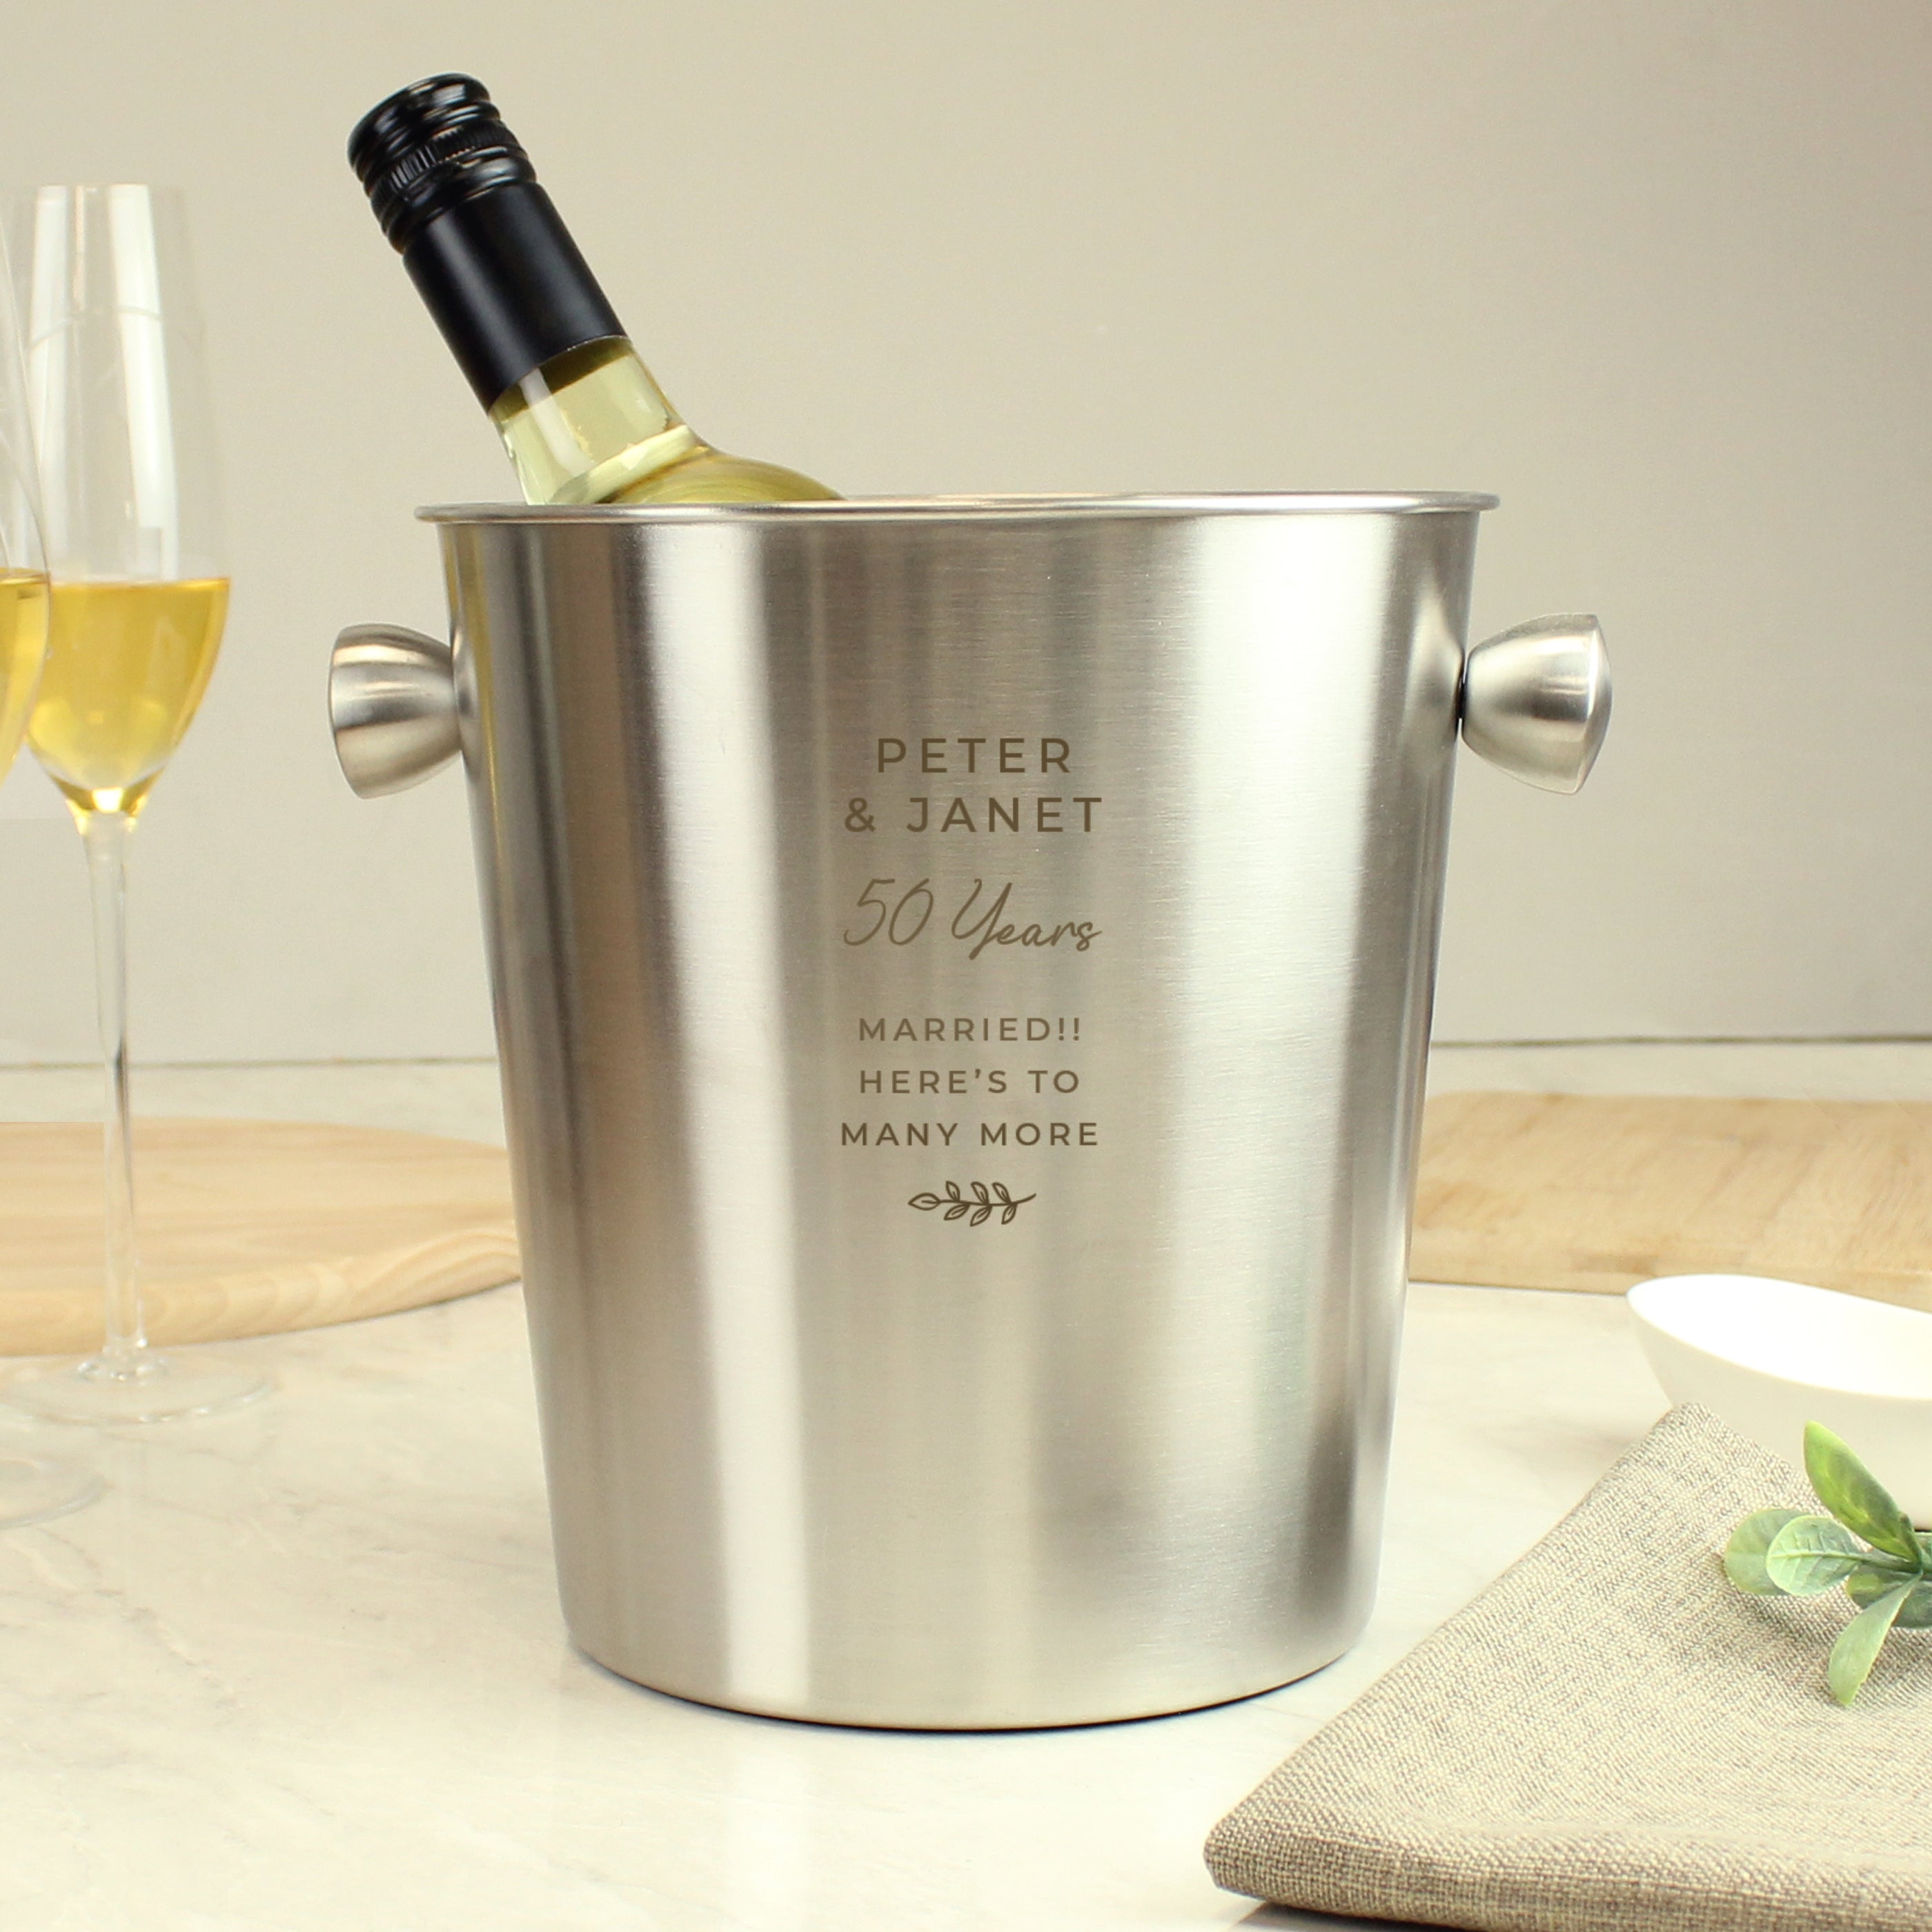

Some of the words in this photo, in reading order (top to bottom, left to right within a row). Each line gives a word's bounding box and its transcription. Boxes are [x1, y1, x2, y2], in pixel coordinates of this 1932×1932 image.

[878, 738, 1071, 773] PETER
[844, 797, 876, 833] &
[906, 797, 1103, 833] JANET
[843, 878, 934, 946] 50
[951, 878, 1103, 960] Years
[859, 1017, 1081, 1042] MARRIED!!
[860, 1068, 1007, 1094] HERE'S
[1027, 1070, 1080, 1094] TO
[841, 1122, 959, 1147] MANY
[980, 1122, 1098, 1147] MORE
